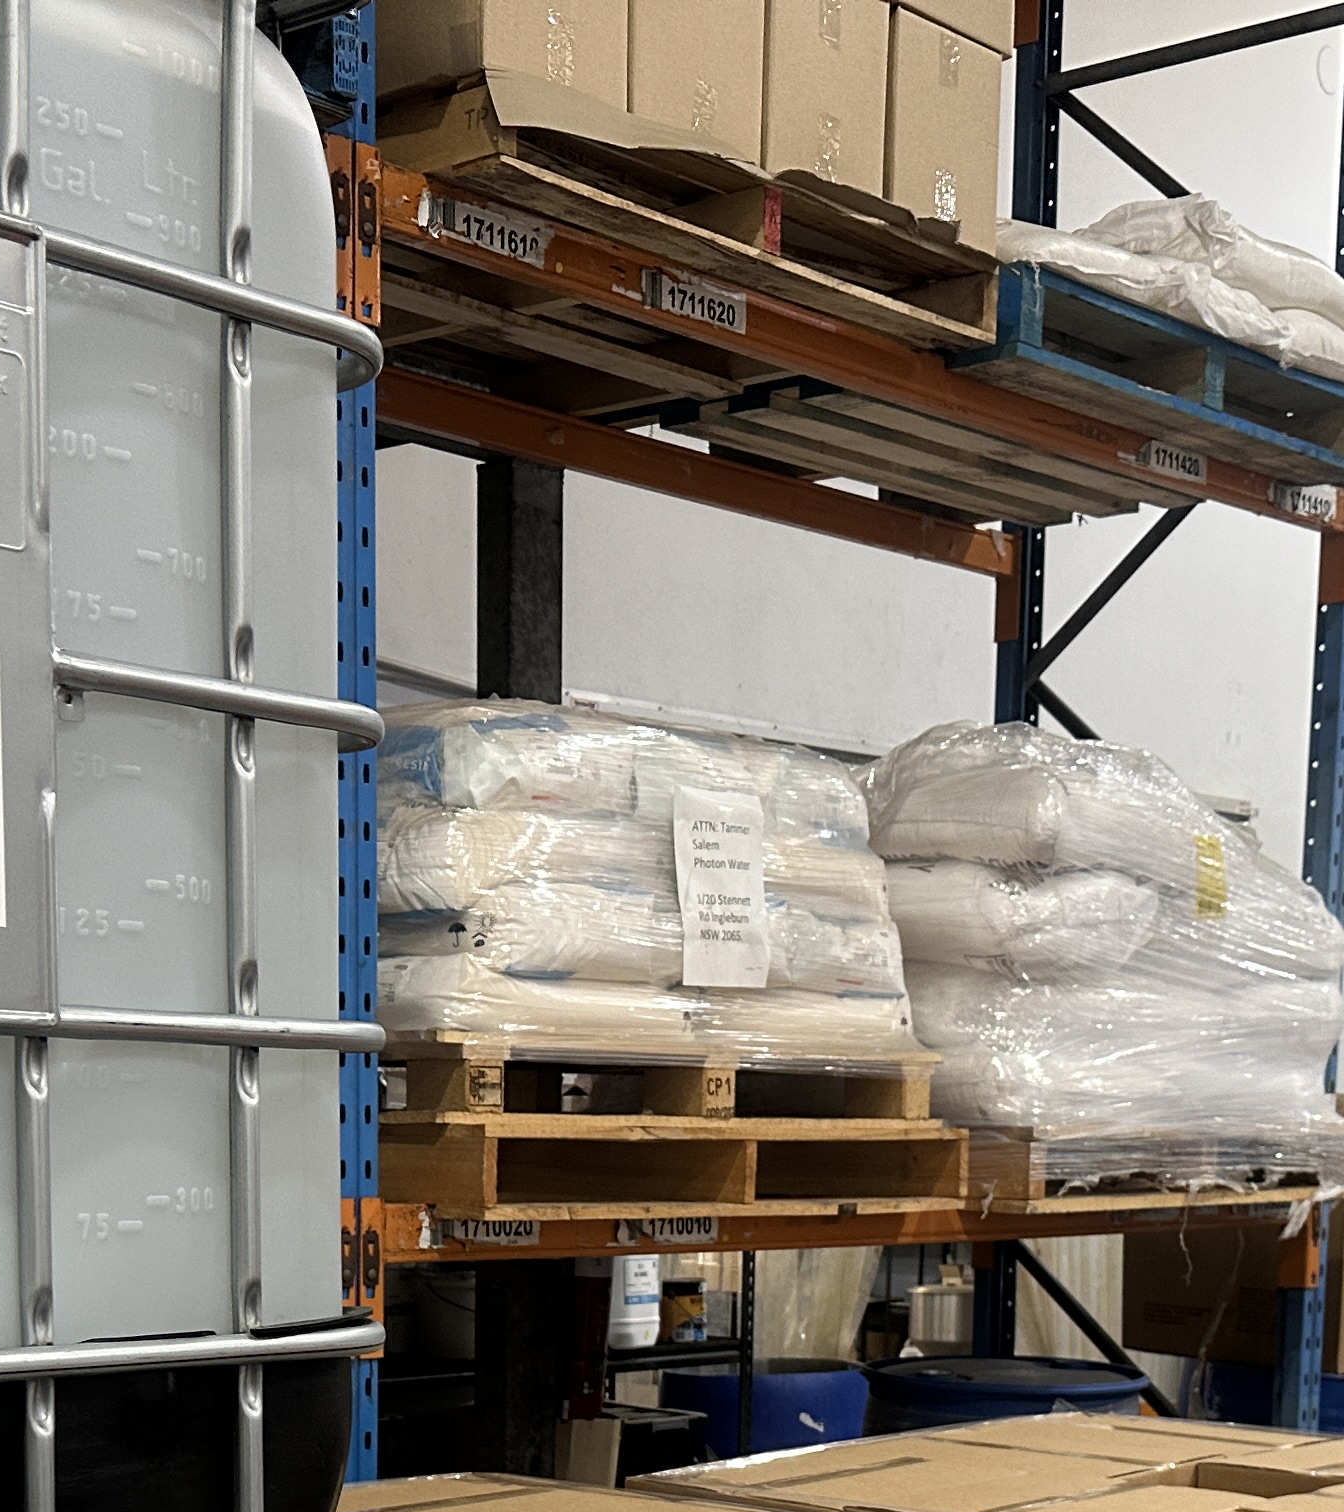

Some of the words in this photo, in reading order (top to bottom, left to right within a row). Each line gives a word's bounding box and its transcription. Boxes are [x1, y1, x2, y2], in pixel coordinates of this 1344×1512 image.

[36, 96, 89, 136] 250
[668, 286, 736, 327] 1711620
[1154, 447, 1200, 477] 1711420
[167, 547, 207, 583] 700
[692, 821, 718, 833] ATTN:
[692, 839, 720, 850] Salem
[694, 857, 726, 869] Photon
[728, 859, 750, 870] Water
[176, 874, 211, 904] 500
[59, 906, 109, 937] 125
[700, 929, 720, 941] NSW
[176, 1187, 214, 1213] 300
[77, 1212, 109, 1240] 75
